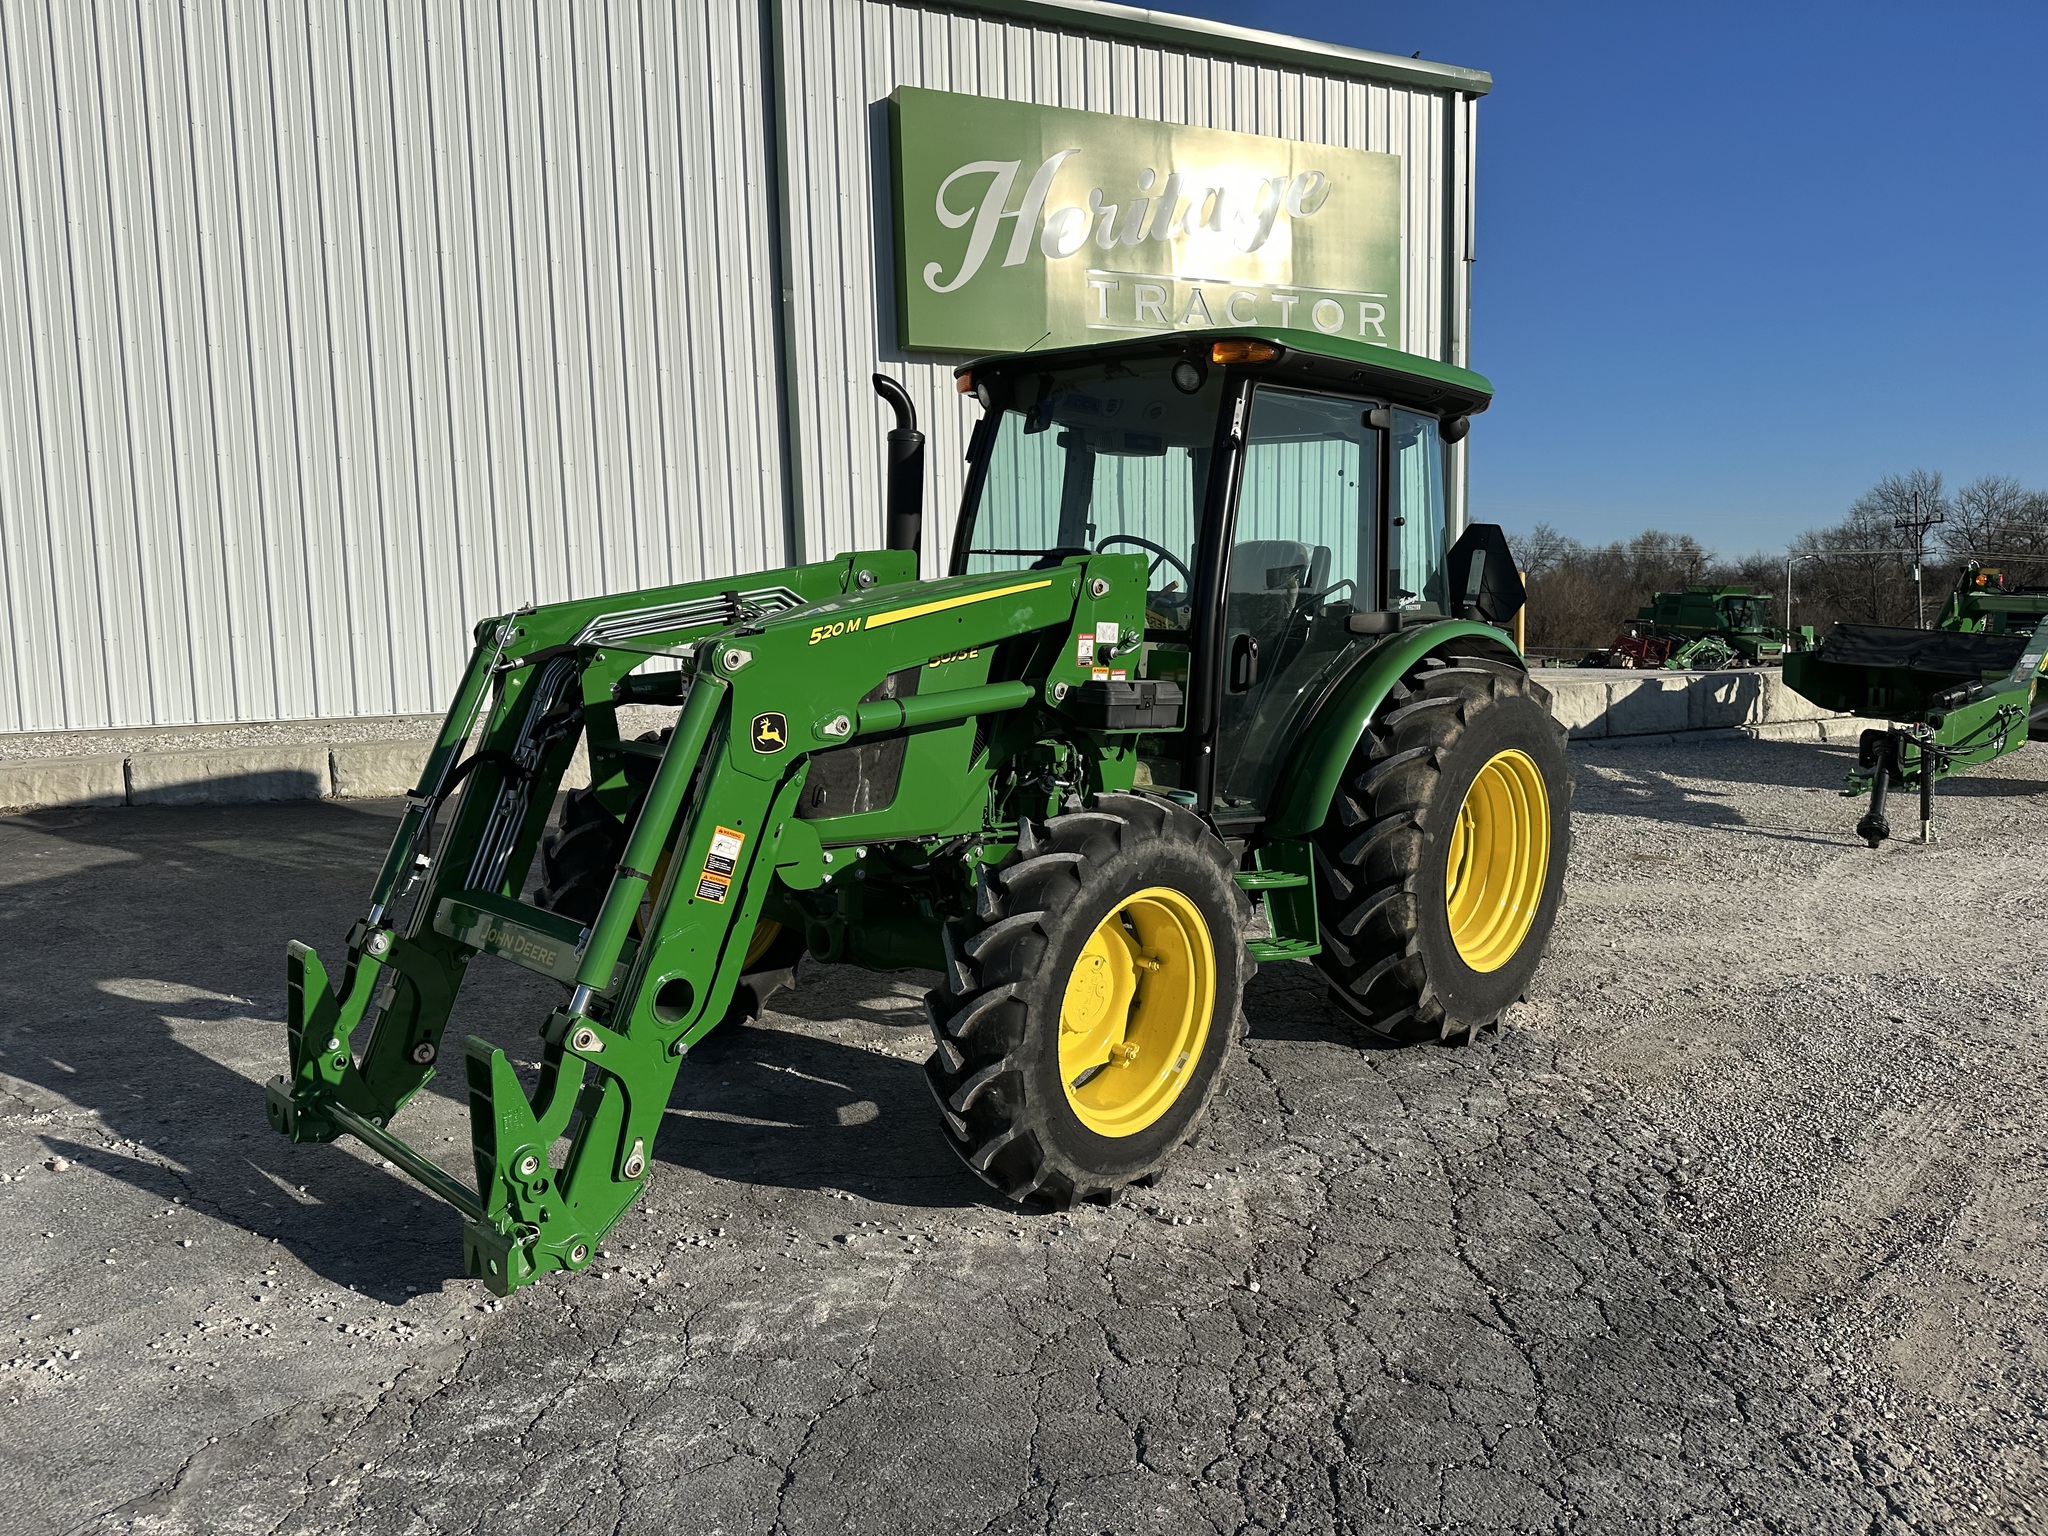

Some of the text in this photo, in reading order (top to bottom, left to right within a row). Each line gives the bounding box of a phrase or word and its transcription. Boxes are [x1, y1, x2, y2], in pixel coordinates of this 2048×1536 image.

[923, 149, 1331, 293] Heritage
[1086, 278, 1387, 338] TRACTOR
[808, 621, 845, 646] 520
[480, 922, 557, 967] JOHN DEERE
